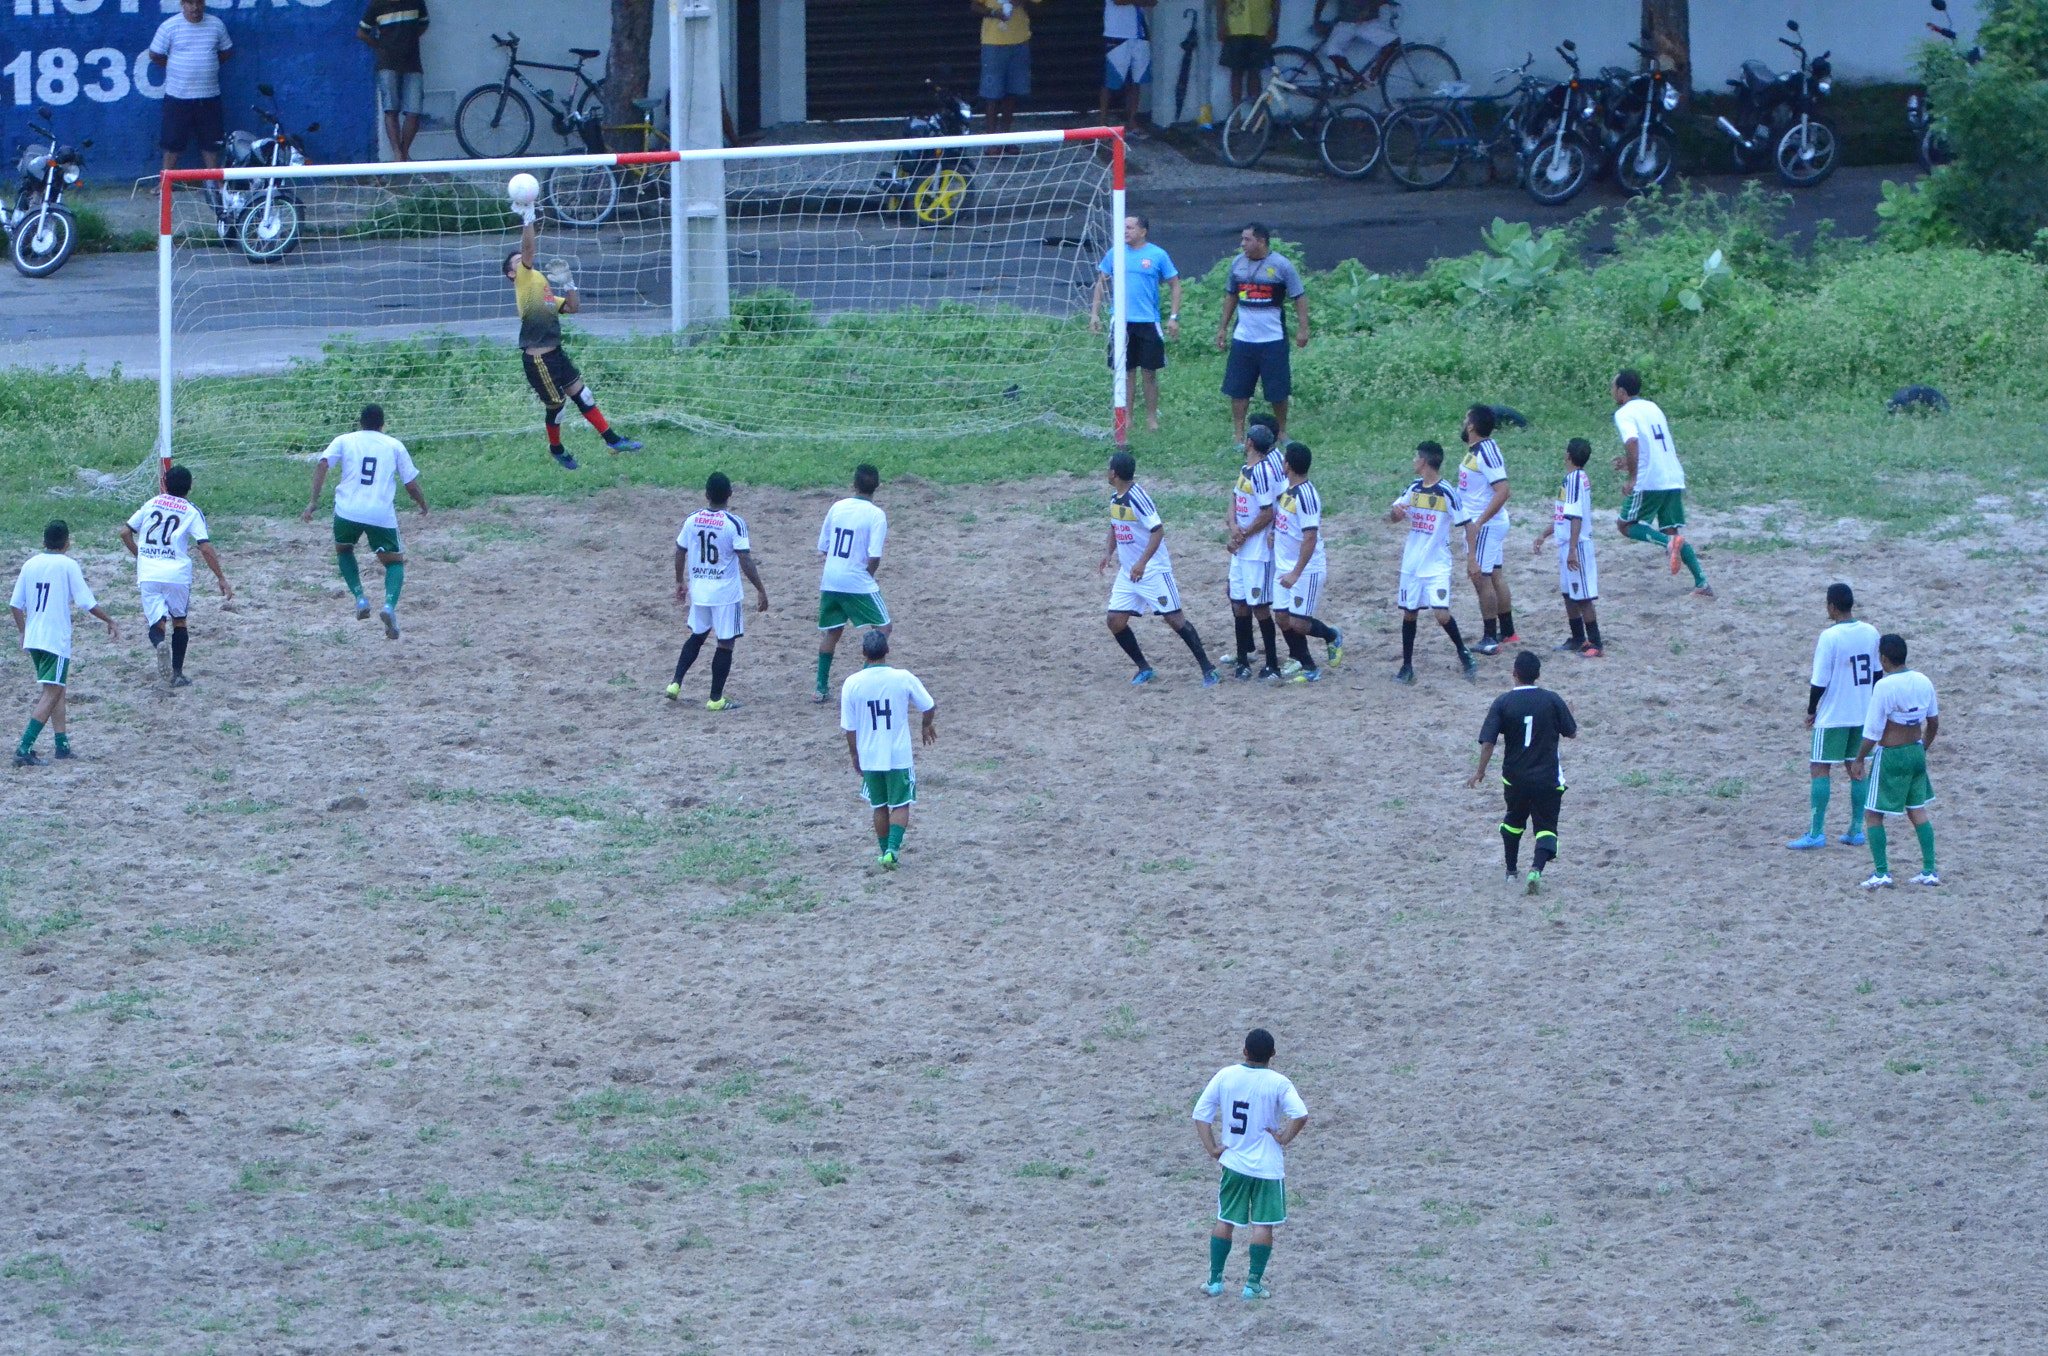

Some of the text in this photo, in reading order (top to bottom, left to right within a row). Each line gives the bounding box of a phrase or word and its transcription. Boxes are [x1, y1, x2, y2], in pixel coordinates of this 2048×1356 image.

[1651, 424, 1667, 452] 4
[361, 457, 377, 485] 9
[146, 510, 180, 546] 20
[833, 527, 854, 559] 10
[697, 530, 718, 565] 16
[35, 582, 51, 613] 11
[1850, 654, 1871, 686] 13
[867, 699, 892, 731] 14
[1523, 715, 1534, 748] 1
[1230, 1101, 1249, 1135] 5
